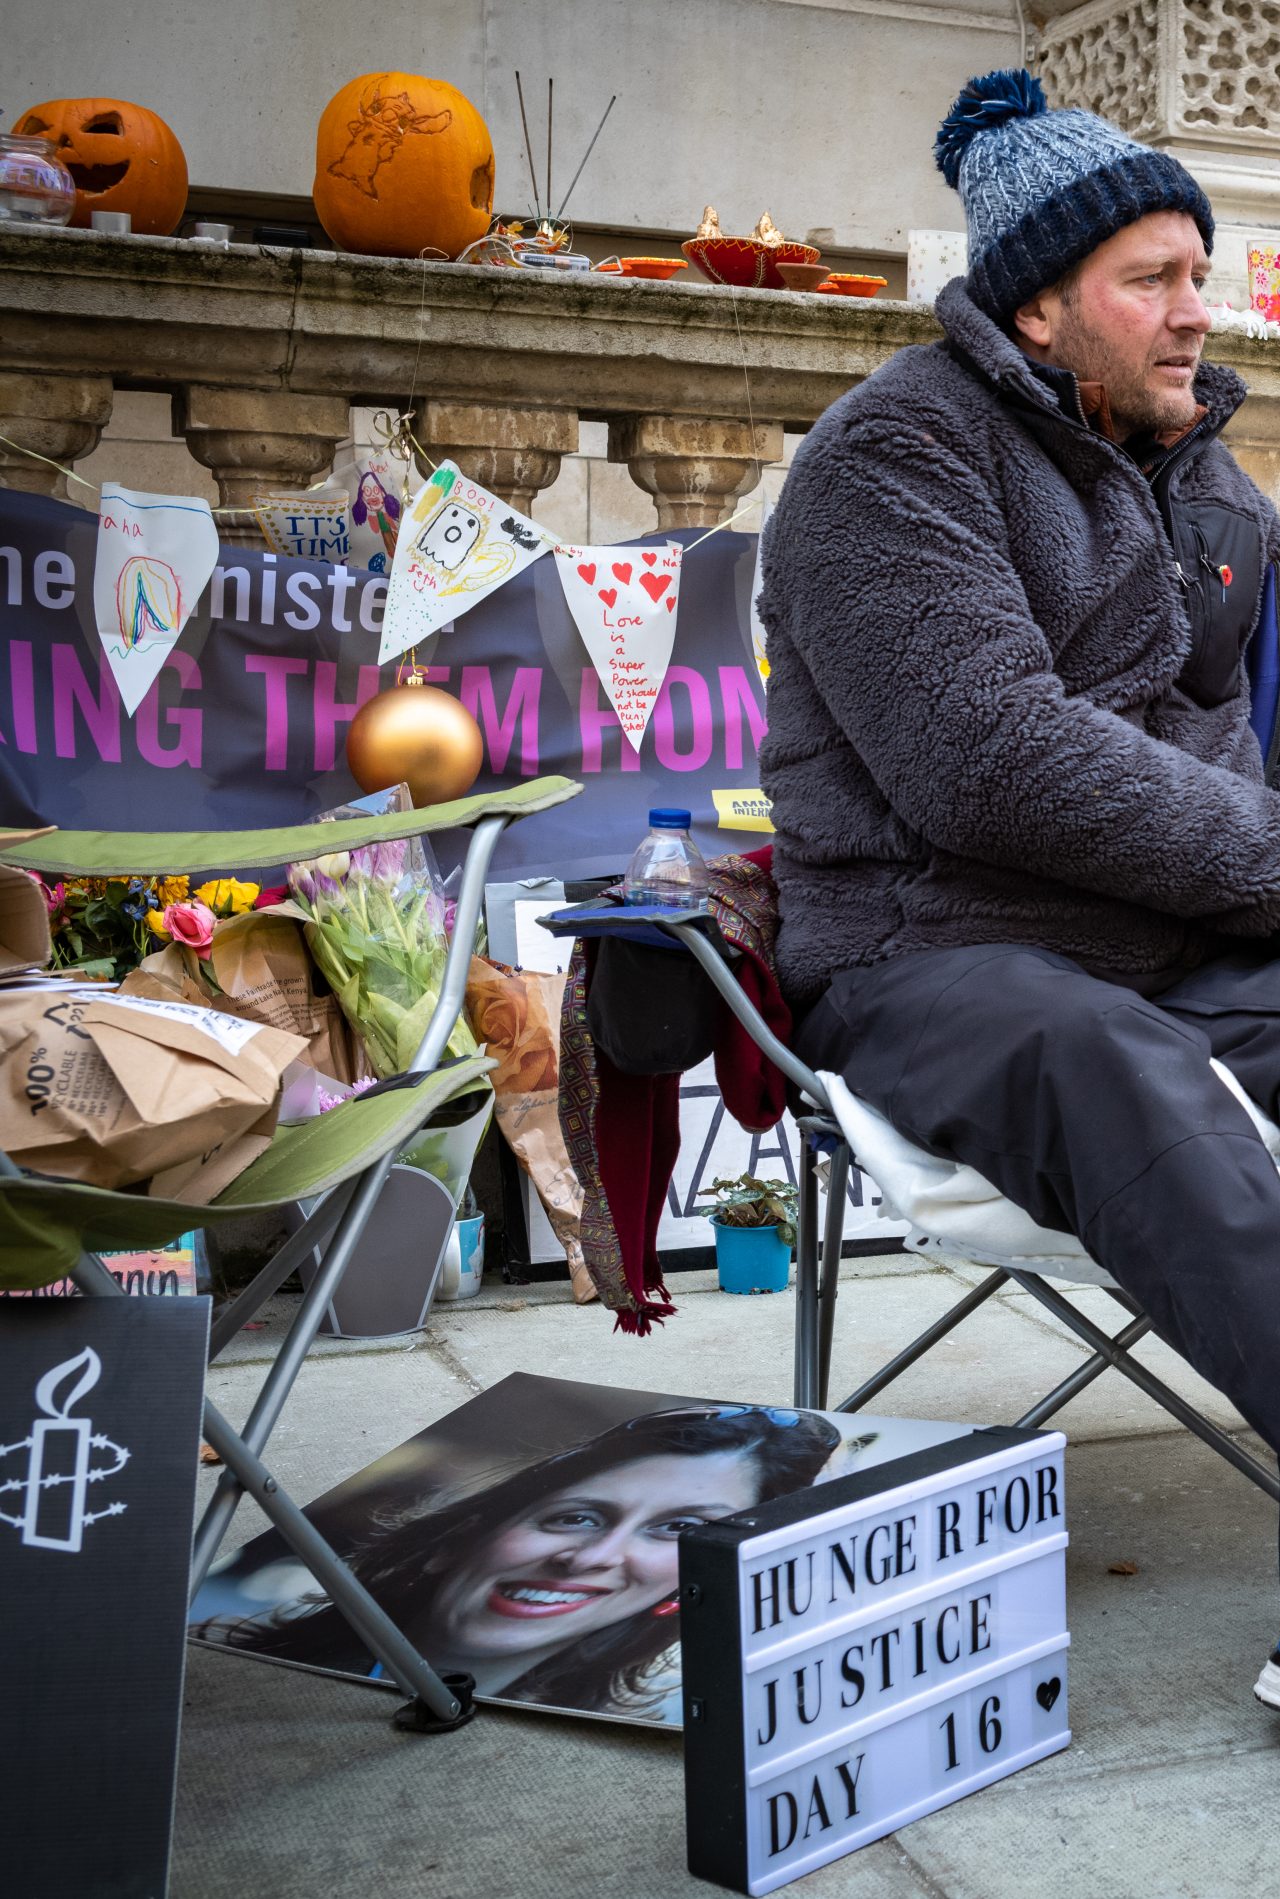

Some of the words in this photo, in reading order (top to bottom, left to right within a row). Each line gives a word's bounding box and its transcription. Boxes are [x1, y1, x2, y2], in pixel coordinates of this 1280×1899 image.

[285, 515, 345, 536] IT'S
[191, 553, 455, 633] niste
[610, 631, 625, 642] is
[615, 647, 625, 655] a
[626, 687, 658, 698] should
[0, 640, 203, 769] ING
[245, 654, 543, 776] THM
[617, 701, 634, 711] not
[636, 698, 647, 709] be
[756, 1593, 992, 1746] JUSTICE
[767, 1753, 866, 1858] DAY
[938, 1695, 1001, 1772] 16
